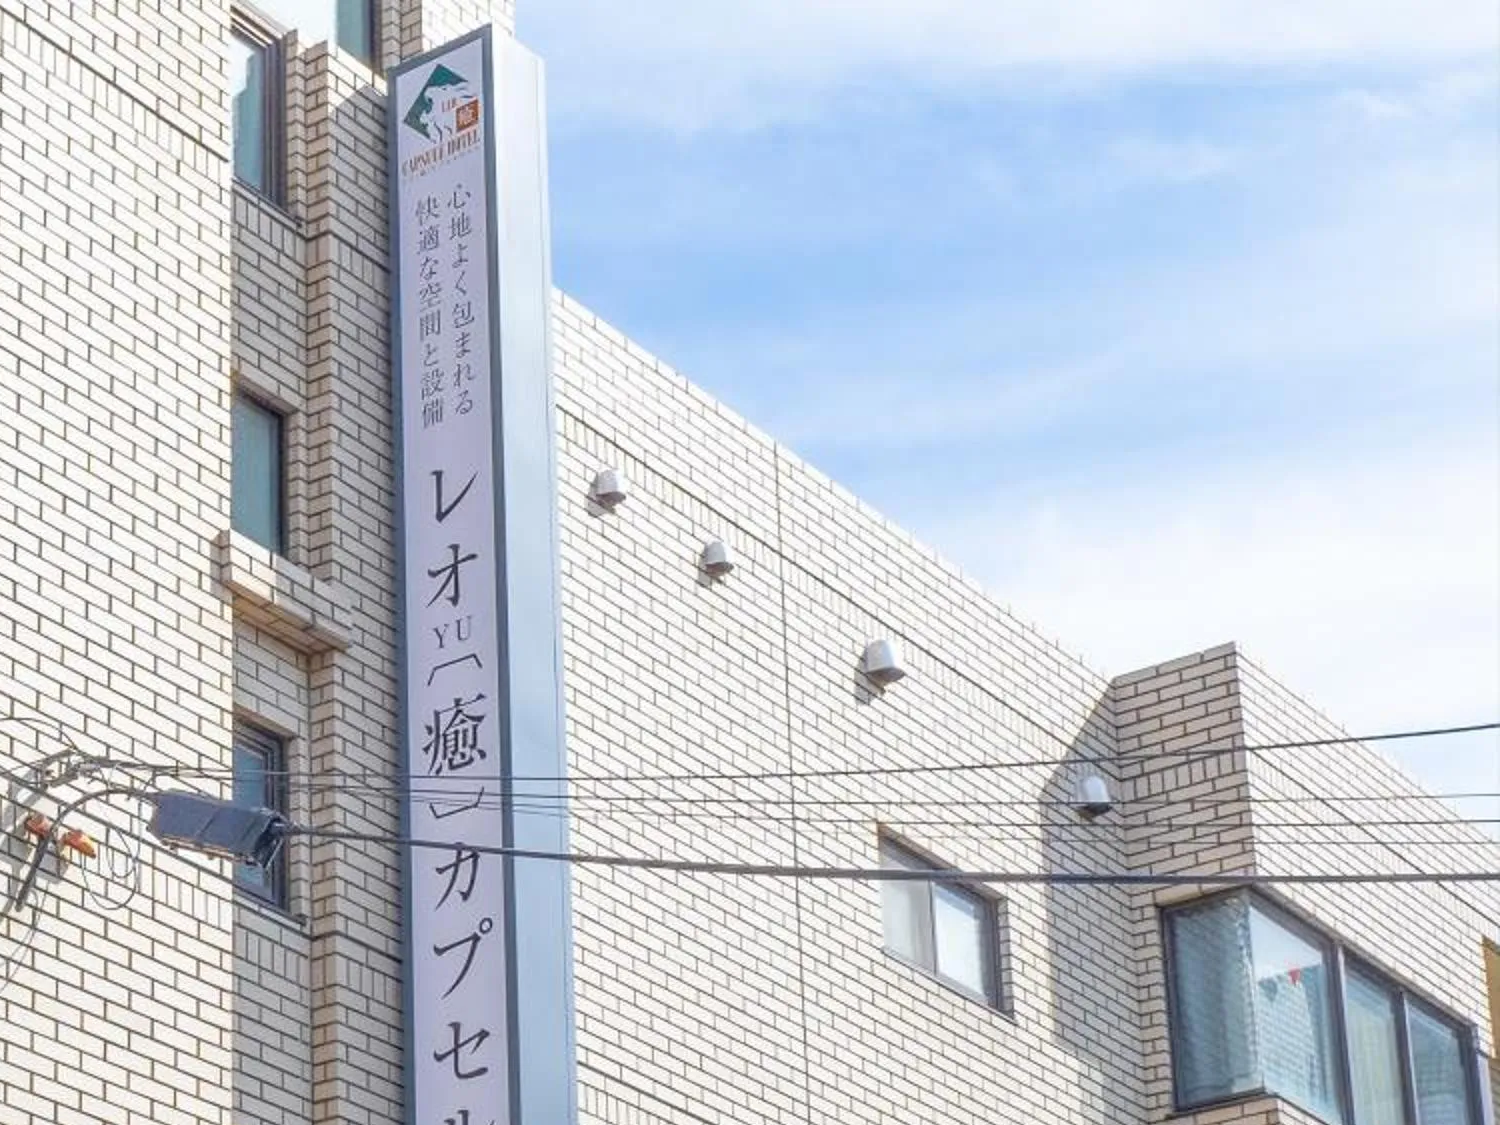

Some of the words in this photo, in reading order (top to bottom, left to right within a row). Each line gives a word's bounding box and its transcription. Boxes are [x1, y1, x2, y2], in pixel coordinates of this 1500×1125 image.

[415, 196, 444, 429] 快適な空間と設備
[447, 182, 475, 416] 心地よく包まれる
